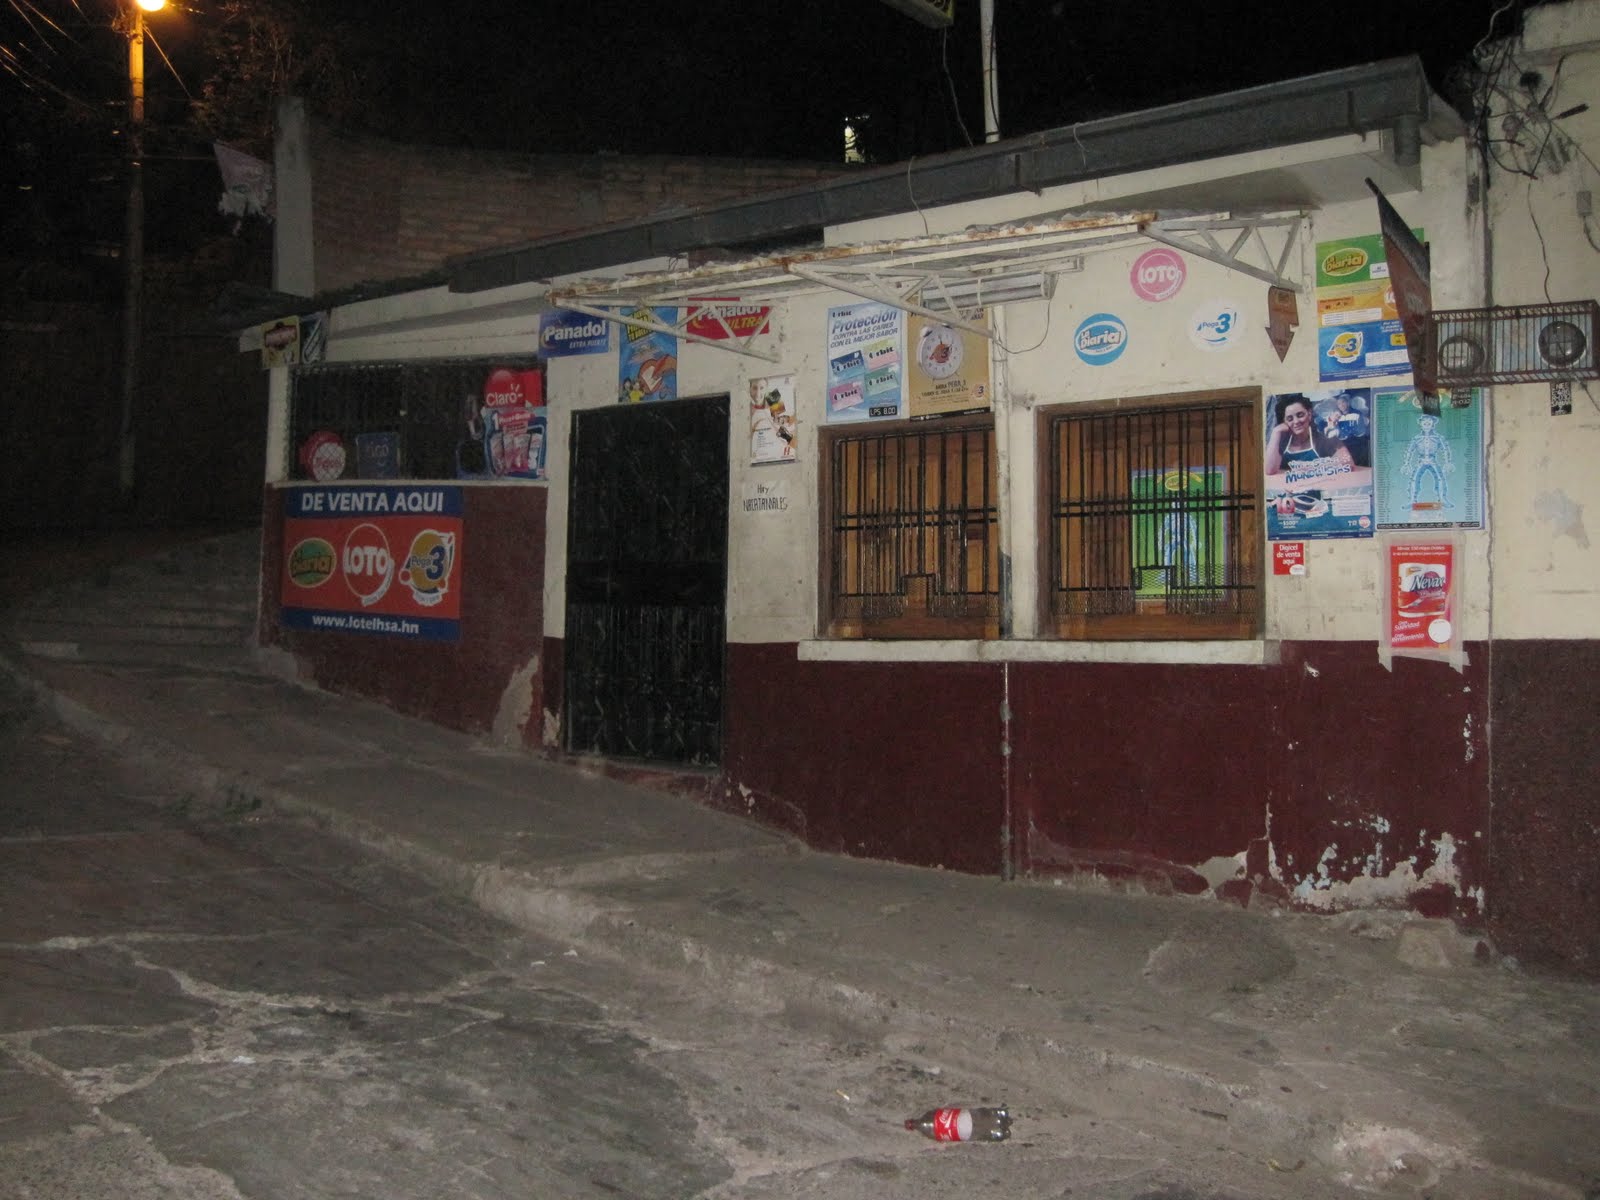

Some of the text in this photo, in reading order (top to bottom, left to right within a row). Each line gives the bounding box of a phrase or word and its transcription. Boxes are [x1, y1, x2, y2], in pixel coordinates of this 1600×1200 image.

[1141, 265, 1179, 284] LOTO
[544, 320, 606, 341] Panadol
[832, 310, 898, 334] Protección
[1215, 313, 1231, 333] 3
[876, 327, 899, 339] SABOR
[1345, 338, 1357, 352] 3
[486, 392, 517, 407] Claro
[302, 492, 444, 512] DE VENTA AQUI
[1279, 544, 1298, 552] Digicel
[343, 546, 390, 577] LOTO
[425, 546, 446, 581] 3
[1411, 575, 1445, 592] Nevax
